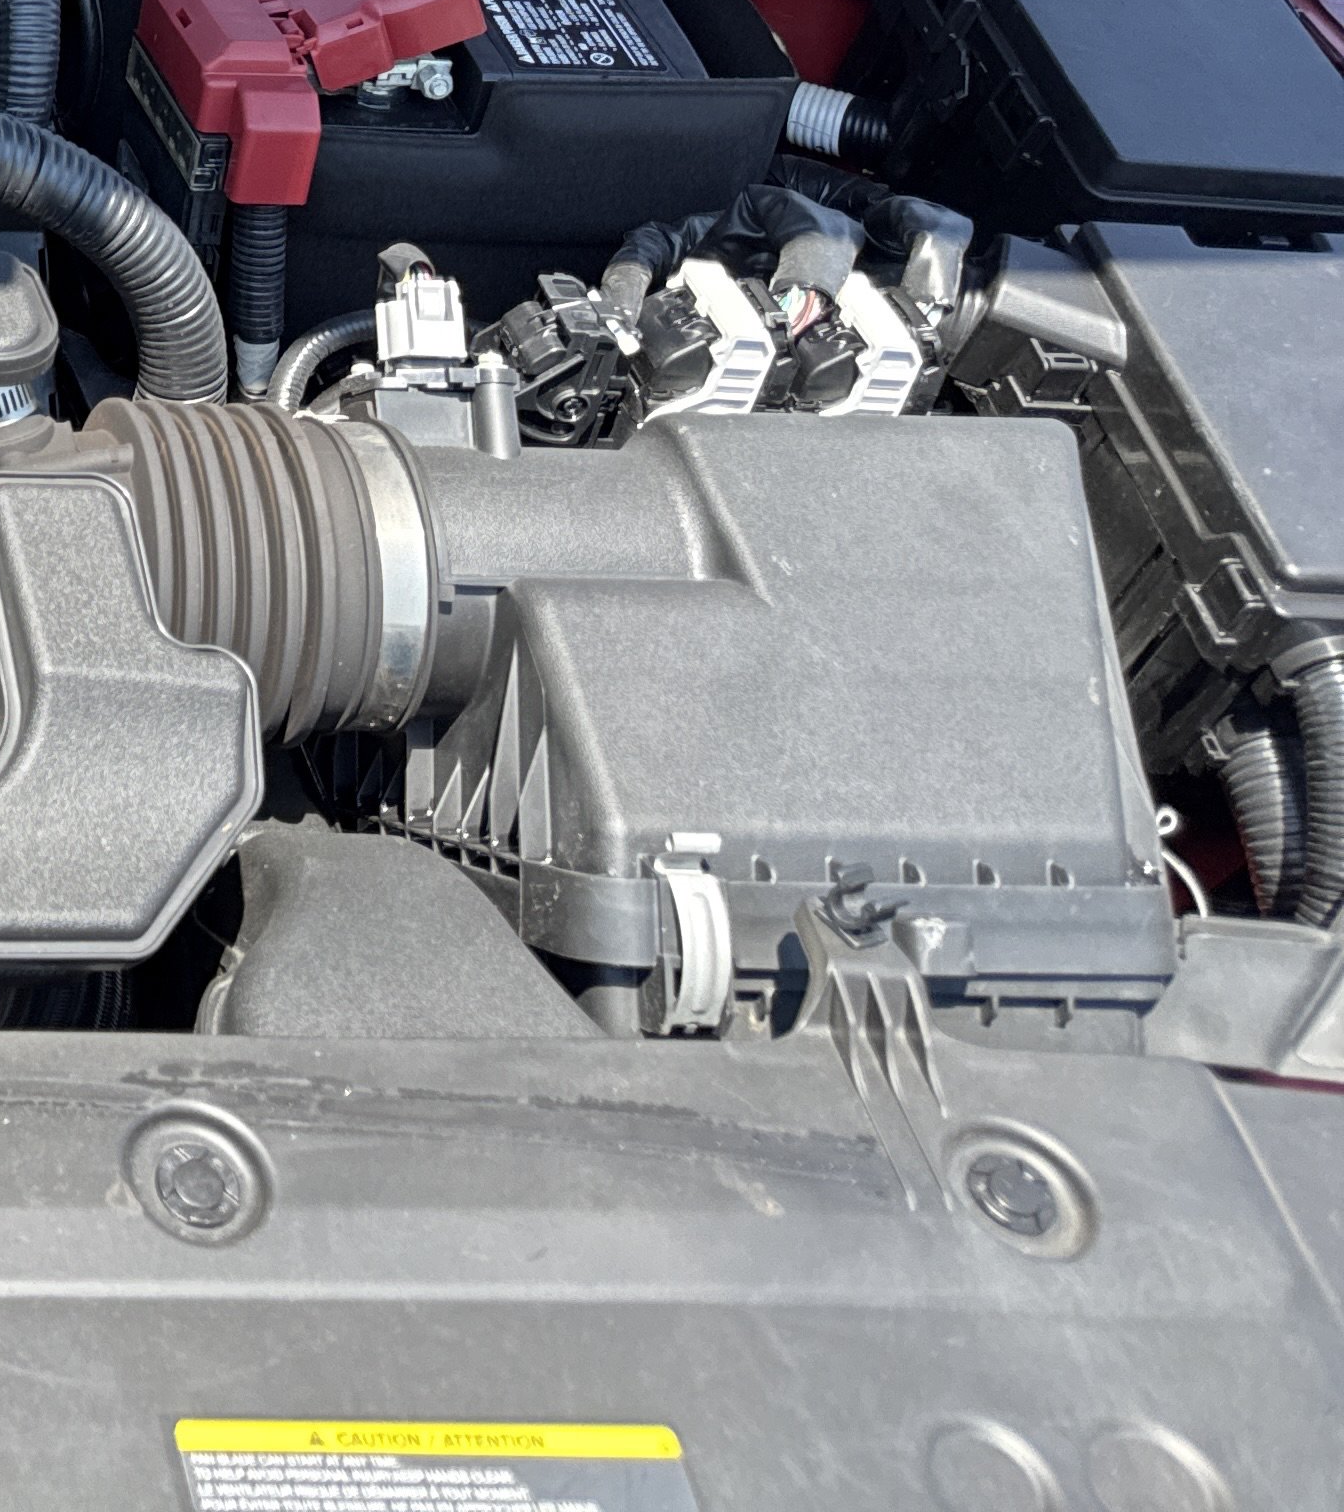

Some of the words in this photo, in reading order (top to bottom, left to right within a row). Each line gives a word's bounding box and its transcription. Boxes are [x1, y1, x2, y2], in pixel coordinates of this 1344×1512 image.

[336, 1431, 421, 1448] CAUTION
[443, 1433, 545, 1450] ATTENTION
[190, 1452, 214, 1465] FAN
[215, 1452, 255, 1466] BLADE
[257, 1453, 285, 1466] CAN
[285, 1453, 322, 1467] START
[324, 1454, 339, 1467] AT
[340, 1454, 368, 1468] ANY
[213, 1467, 245, 1481] HELP
